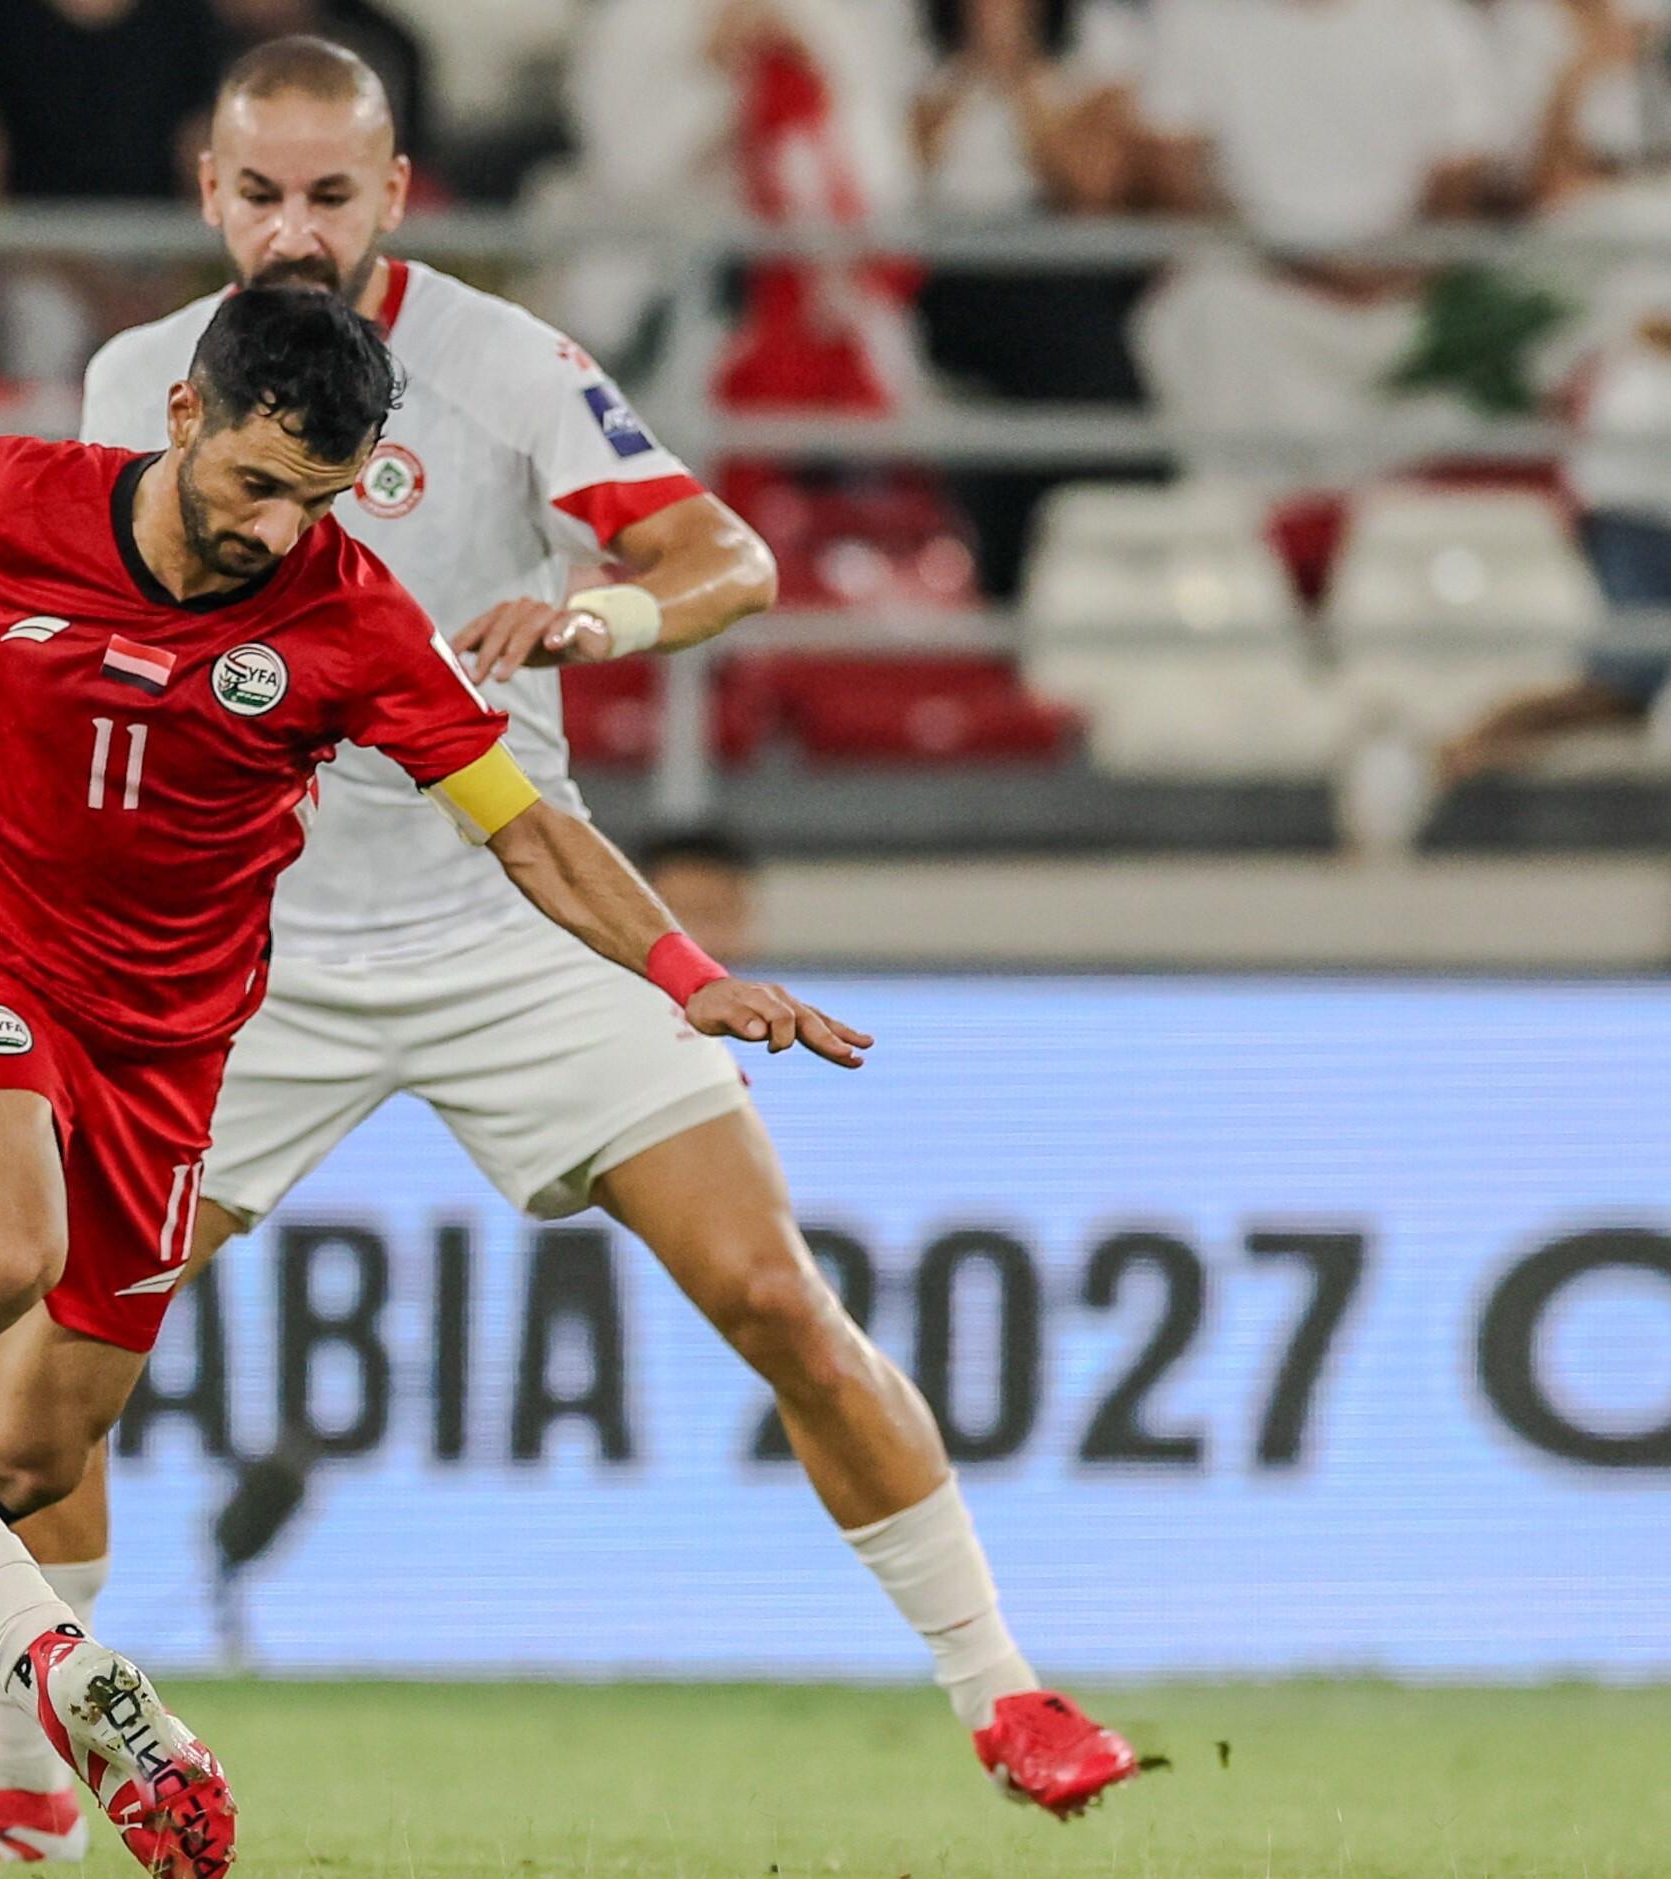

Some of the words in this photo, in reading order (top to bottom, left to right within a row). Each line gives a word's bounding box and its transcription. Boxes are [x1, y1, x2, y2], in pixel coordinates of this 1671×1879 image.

[249, 667, 277, 687] YFA
[88, 717, 148, 809] 11
[160, 1161, 203, 1261] 11
